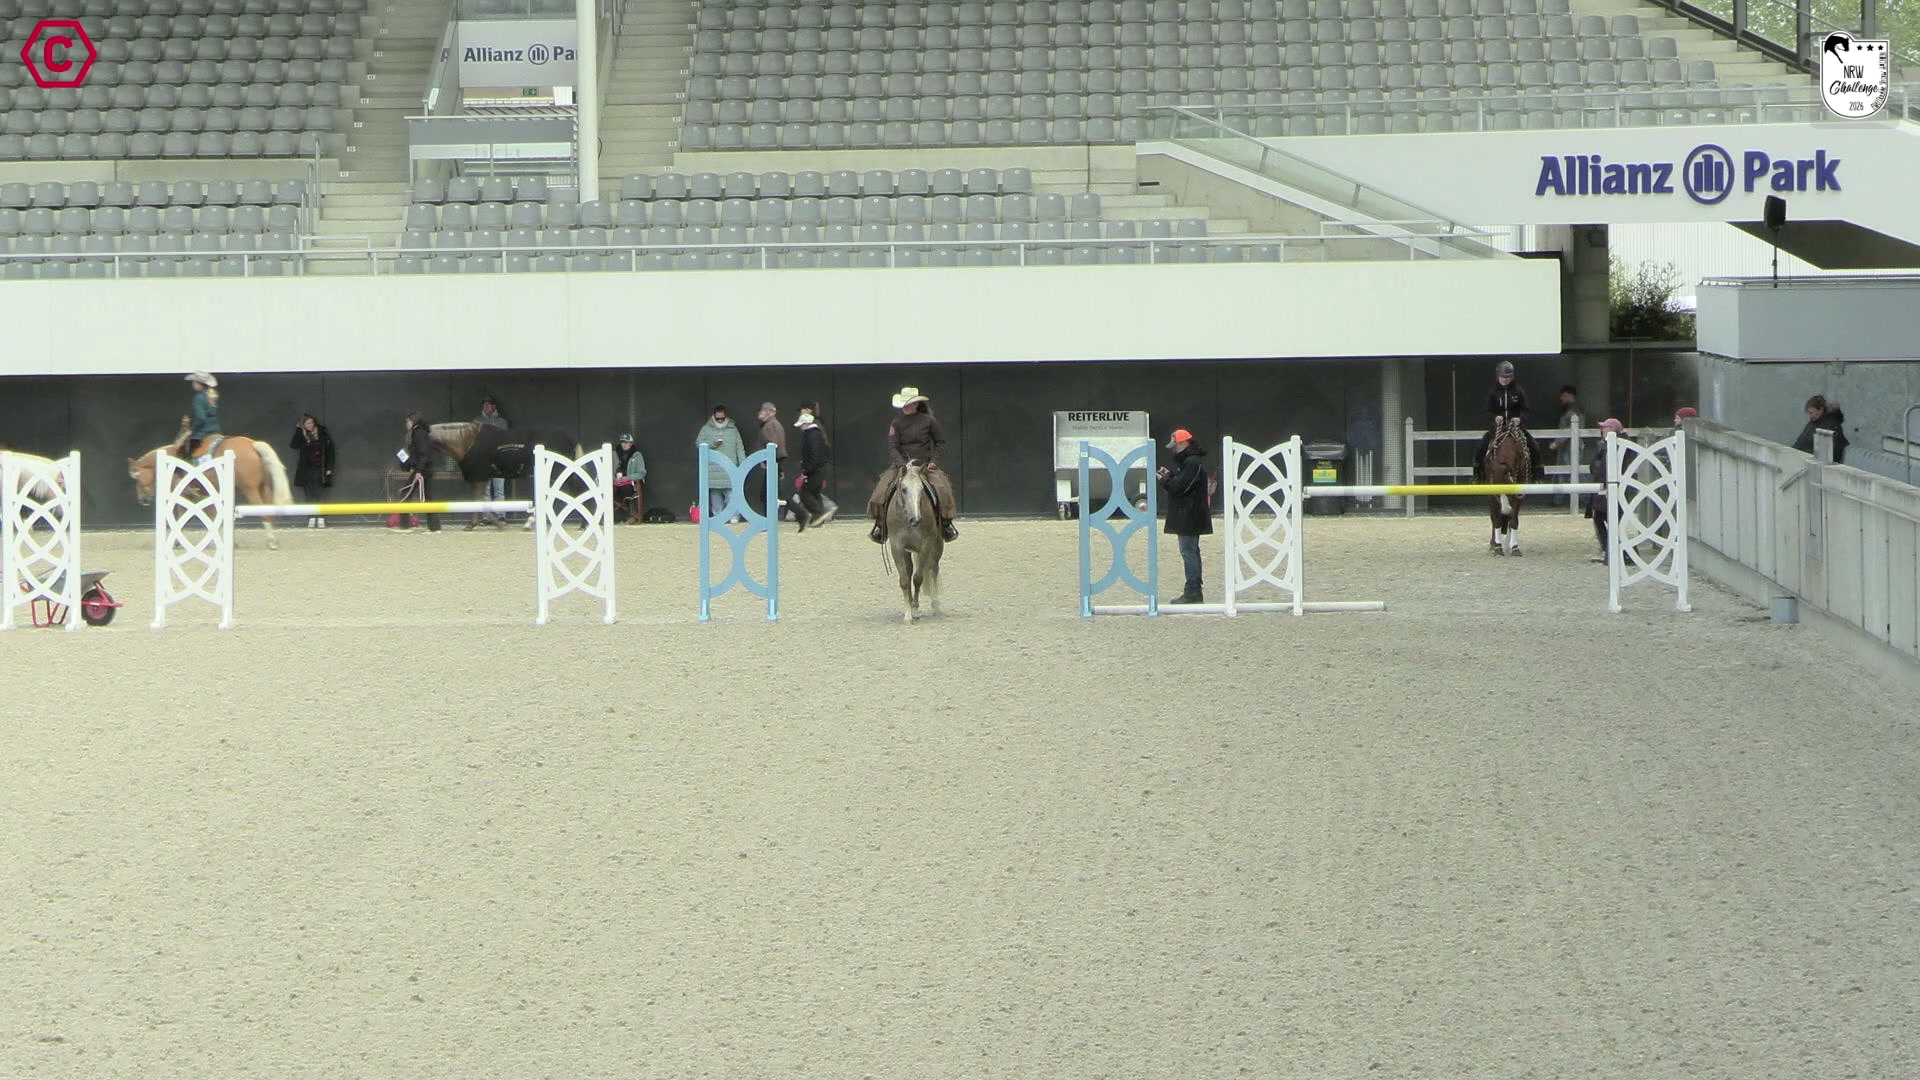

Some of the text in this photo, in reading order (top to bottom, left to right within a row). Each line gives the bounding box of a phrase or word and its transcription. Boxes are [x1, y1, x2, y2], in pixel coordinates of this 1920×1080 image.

[464, 46, 524, 62] Allianz
[553, 46, 577, 61] Pa
[1535, 149, 1842, 195] Allianz Park
[1068, 412, 1130, 421] REITERLIVE
